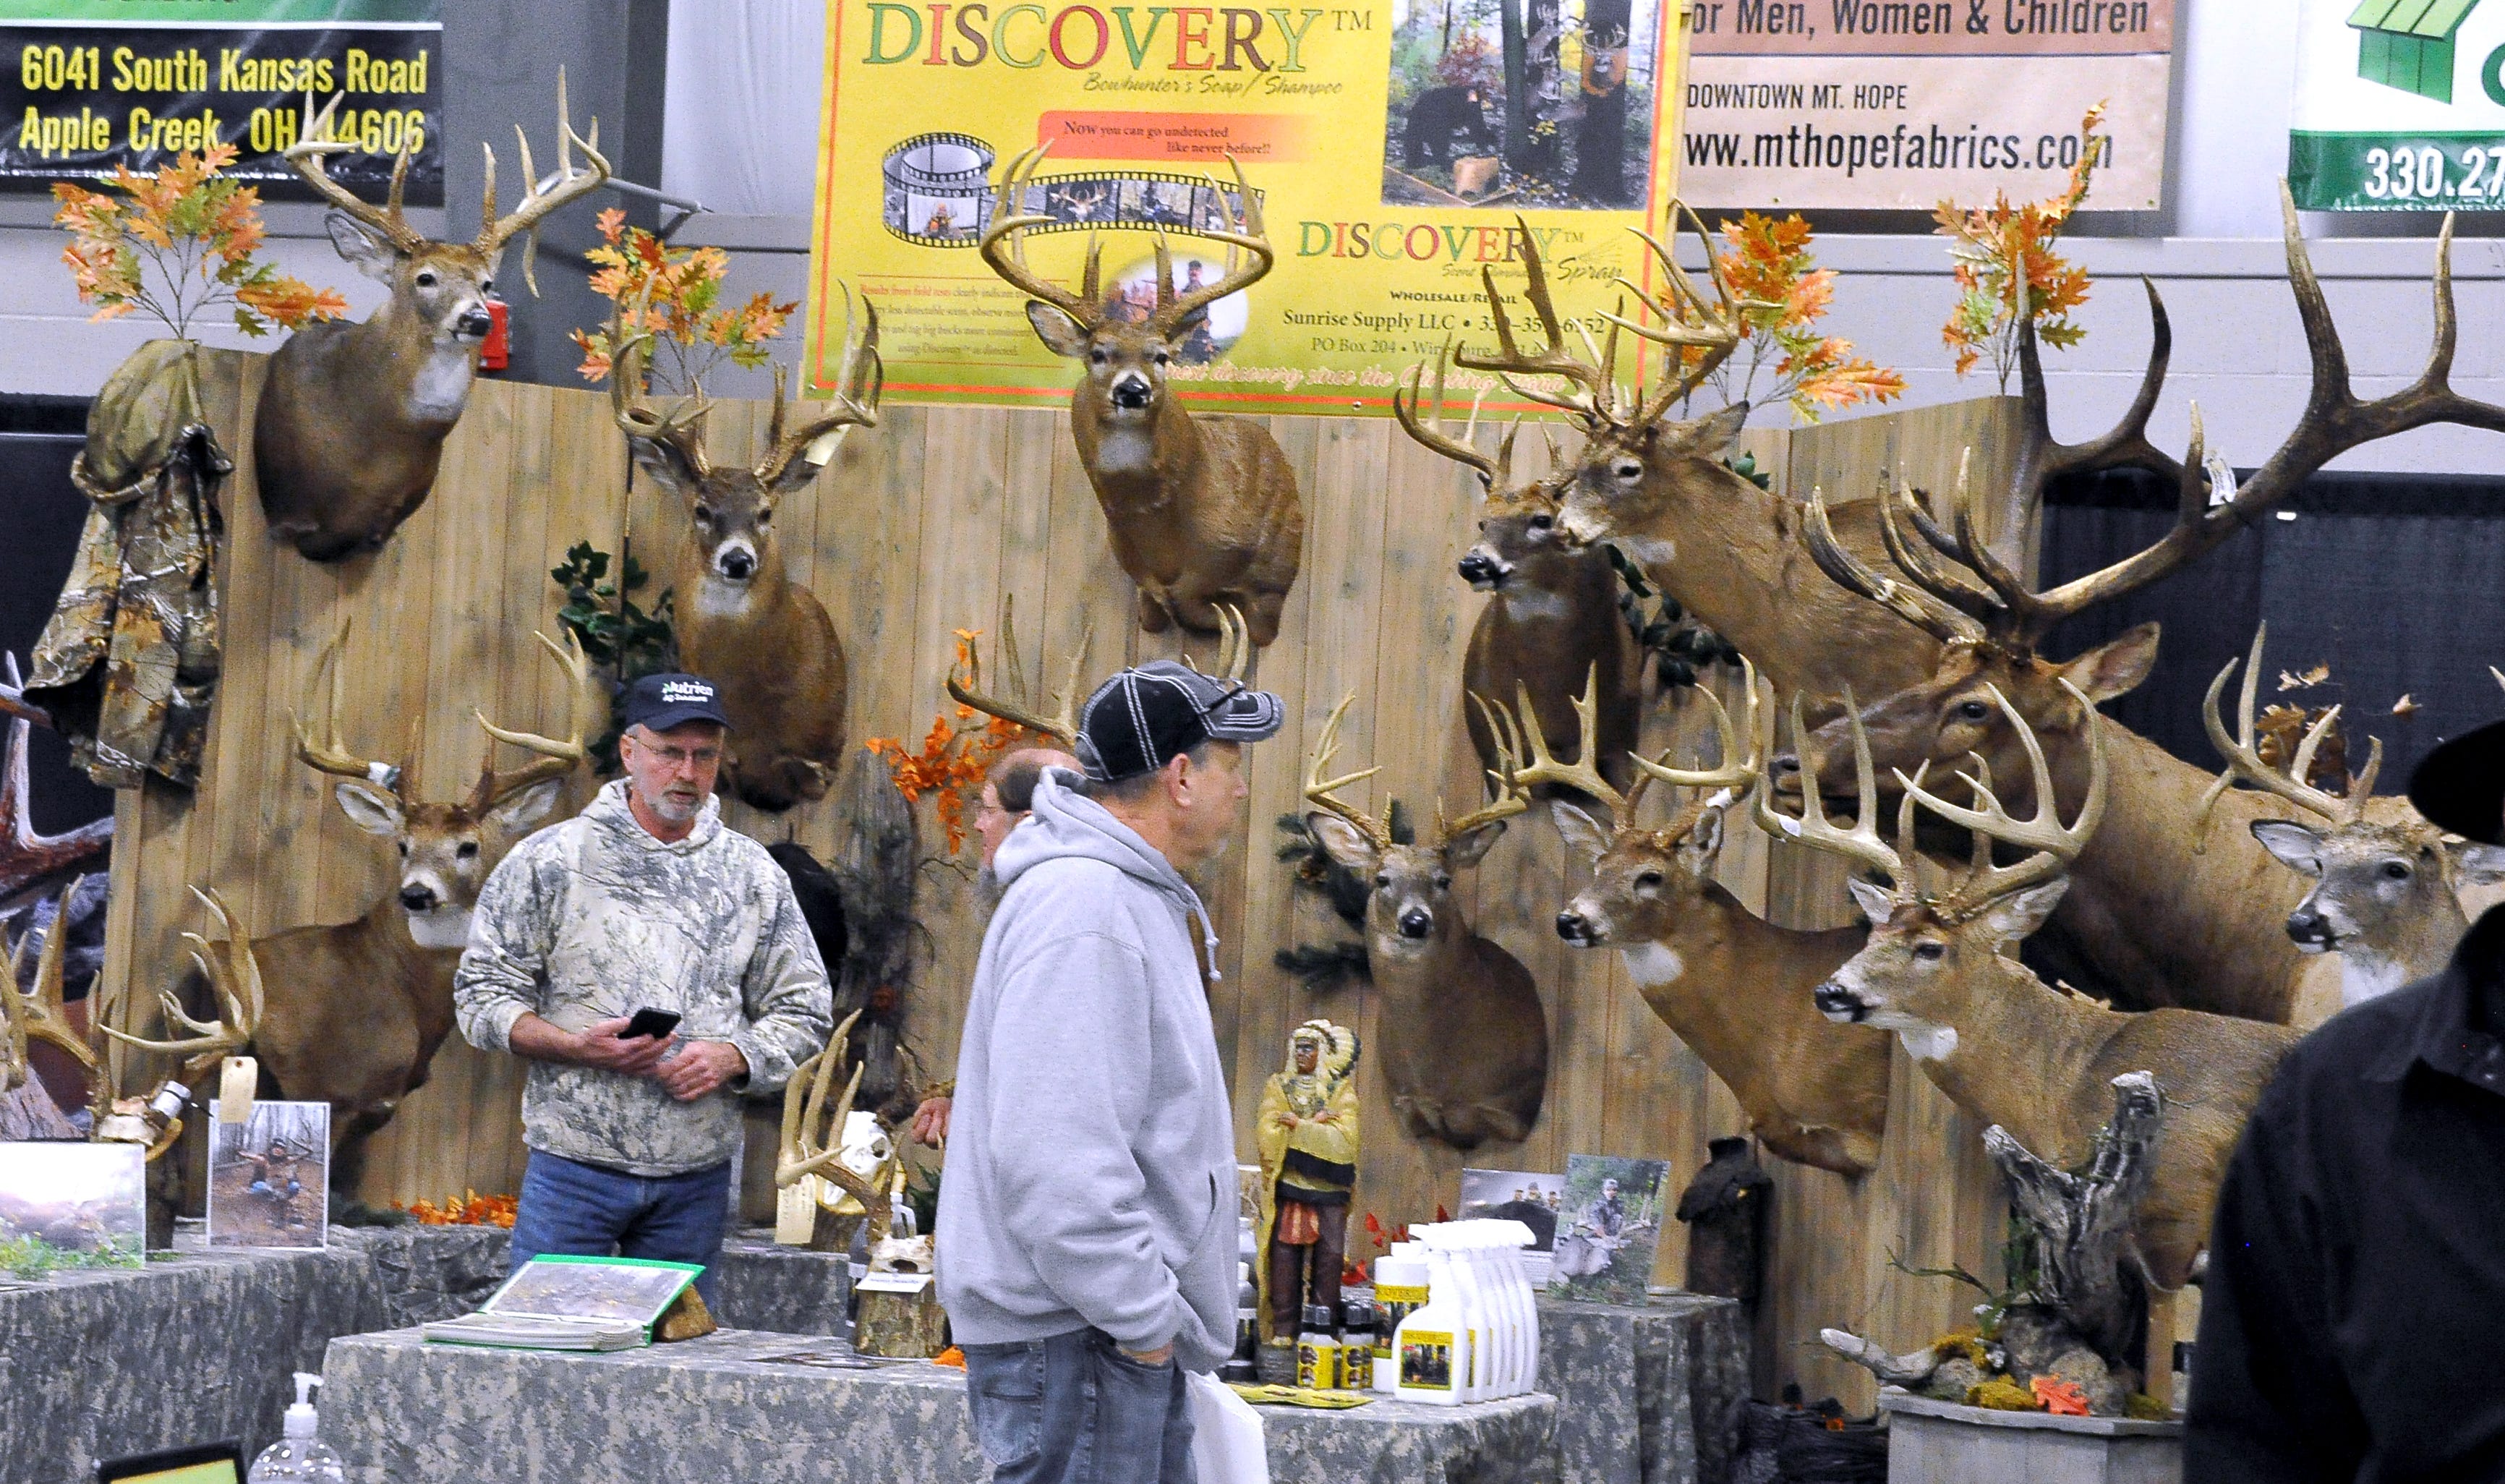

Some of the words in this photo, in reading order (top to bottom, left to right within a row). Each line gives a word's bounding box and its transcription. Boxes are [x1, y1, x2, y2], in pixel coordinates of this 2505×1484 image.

[1737, 0, 1814, 40] Men,
[1833, 0, 1952, 35] Women
[1966, 1, 1989, 34] &
[2005, 0, 2148, 34] Children
[862, 4, 1323, 72] DISCOVERY
[21, 45, 100, 91] 6041
[113, 47, 208, 93] South
[220, 48, 334, 94] Kansas
[347, 49, 427, 94] Road
[1083, 72, 1192, 93] Bowhunter's
[1688, 84, 1804, 109] DOWNTOWN
[1812, 85, 1845, 109] MT.
[1854, 85, 1907, 110] HOPE
[20, 106, 110, 159] Apple
[129, 108, 221, 153] Creek
[250, 108, 296, 153] OH
[1064, 121, 1099, 136] Now
[1101, 127, 1121, 138] you
[1124, 127, 1144, 137] can
[1147, 128, 1161, 139] go
[1165, 125, 1229, 137] undetected
[1166, 142, 1188, 153] like
[1192, 144, 1224, 154] never
[1296, 221, 1563, 263] DISCOVERY
[1390, 290, 1517, 304] WHOLESALE/REAIL
[1284, 310, 1351, 327] Sunrise
[1353, 311, 1413, 333] Supply
[1419, 313, 1455, 331] LLC
[1311, 338, 1335, 352] PO
[1339, 338, 1366, 353] Box
[1371, 339, 1395, 353] 204
